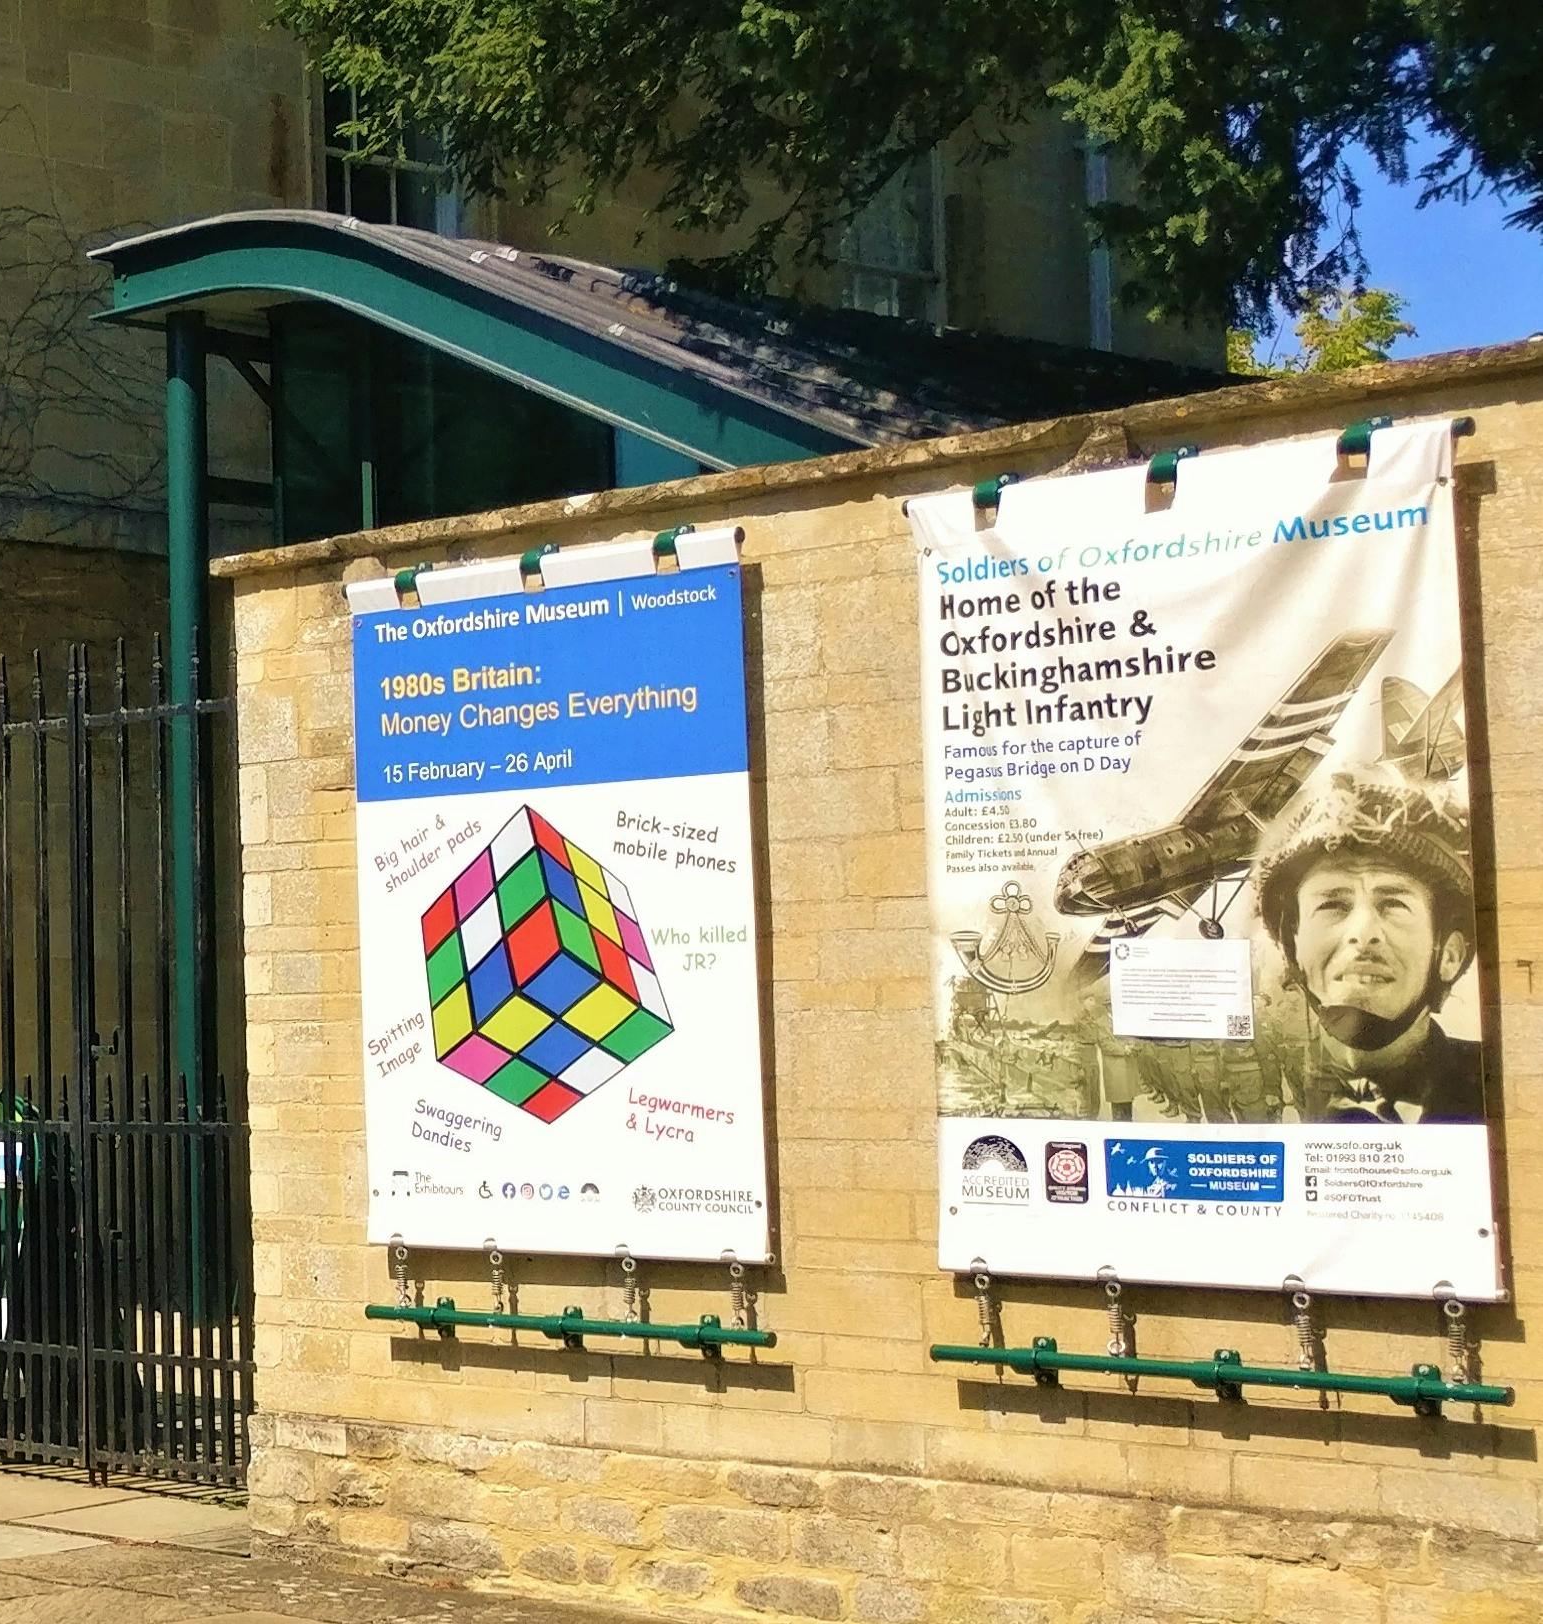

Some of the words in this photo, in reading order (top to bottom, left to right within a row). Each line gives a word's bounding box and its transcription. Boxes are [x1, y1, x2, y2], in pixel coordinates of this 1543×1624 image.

[936, 556, 1030, 585] Soldiers
[1037, 546, 1072, 574] of
[1079, 527, 1262, 569] Oxfordshire
[1272, 505, 1429, 545] Museum
[939, 590, 1021, 620] Home
[1030, 581, 1056, 610] of
[1065, 577, 1122, 607] the
[374, 623, 408, 644] The
[411, 607, 520, 638] Oxfordshire
[525, 597, 610, 623] Museum
[631, 584, 717, 610] Woodstock
[940, 616, 1116, 657] Oxfordshire
[1129, 609, 1157, 637] &
[380, 674, 446, 700] 1980s
[452, 663, 542, 694] Britain:
[941, 647, 1217, 694] Buckinghamshire
[381, 709, 452, 742] Money
[458, 698, 560, 730] Changes
[568, 683, 697, 719] Everything
[942, 703, 1017, 737] Light
[1026, 693, 1154, 725] Infantry
[944, 743, 998, 760] Famous
[1001, 740, 1027, 756] for
[1030, 738, 1055, 755] the
[1058, 735, 1120, 758] capture
[1123, 731, 1142, 748] of
[383, 765, 403, 784] 15
[408, 759, 485, 784] February
[505, 754, 528, 773] 26
[533, 749, 573, 775] April
[944, 765, 1003, 783] Pegasus
[1007, 758, 1057, 780] Bridge
[1060, 761, 1080, 774] on
[1084, 757, 1095, 771] D
[1100, 755, 1132, 775] Day
[944, 788, 1022, 804] Admissions
[944, 807, 978, 818] Adult:
[981, 805, 1010, 816] £4.50
[616, 810, 719, 843] Brick-sized
[945, 820, 1006, 832] Concession
[1009, 818, 1037, 830] £3.80
[374, 850, 399, 873] Big
[401, 827, 430, 856] hair
[435, 814, 446, 829] &
[945, 834, 994, 846] Children:
[1025, 832, 1062, 844] (under
[1078, 829, 1104, 841] free)
[386, 844, 443, 893] shoulder
[447, 819, 483, 854] pads
[613, 839, 668, 861] mobile
[675, 850, 737, 873] phones
[946, 850, 975, 861] Family
[978, 849, 1012, 859] Tickets
[1027, 847, 1058, 857] Annual
[946, 864, 976, 873] Passes
[978, 863, 999, 872] also
[651, 928, 691, 945] Who
[698, 926, 747, 943] killed
[682, 954, 717, 972] JR?
[368, 1010, 426, 1056] Spitting
[376, 1041, 423, 1078] Image
[628, 1087, 735, 1125] Legwarmers
[414, 1099, 503, 1141] Swaggering
[625, 1113, 637, 1130] &
[645, 1117, 694, 1143] Lycra
[411, 1121, 472, 1153] Dandies
[1304, 1141, 1403, 1152] www.sofo.org.uk
[1187, 1153, 1256, 1165] SOLDIERS
[1259, 1154, 1278, 1165] OF
[1304, 1153, 1324, 1163] Tel:
[1326, 1153, 1356, 1163] 01993
[1359, 1153, 1380, 1163] 810
[1383, 1154, 1405, 1164] 210
[415, 1172, 432, 1183] The
[963, 1175, 1029, 1187] ACCREDITED
[1188, 1168, 1278, 1178] OXFORDSHIRE
[1304, 1166, 1332, 1175] Email:
[658, 1188, 754, 1202] OXFORDSHIRE
[962, 1185, 1030, 1200] MUSEUM
[1209, 1180, 1260, 1191] MUSEUM
[658, 1202, 702, 1213] COUNTY
[705, 1203, 754, 1214] COUNCIL
[1107, 1200, 1189, 1215] CONFLICT
[1197, 1204, 1208, 1216] &
[1216, 1204, 1283, 1217] COUNTY
[1350, 1210, 1383, 1221] Charity
